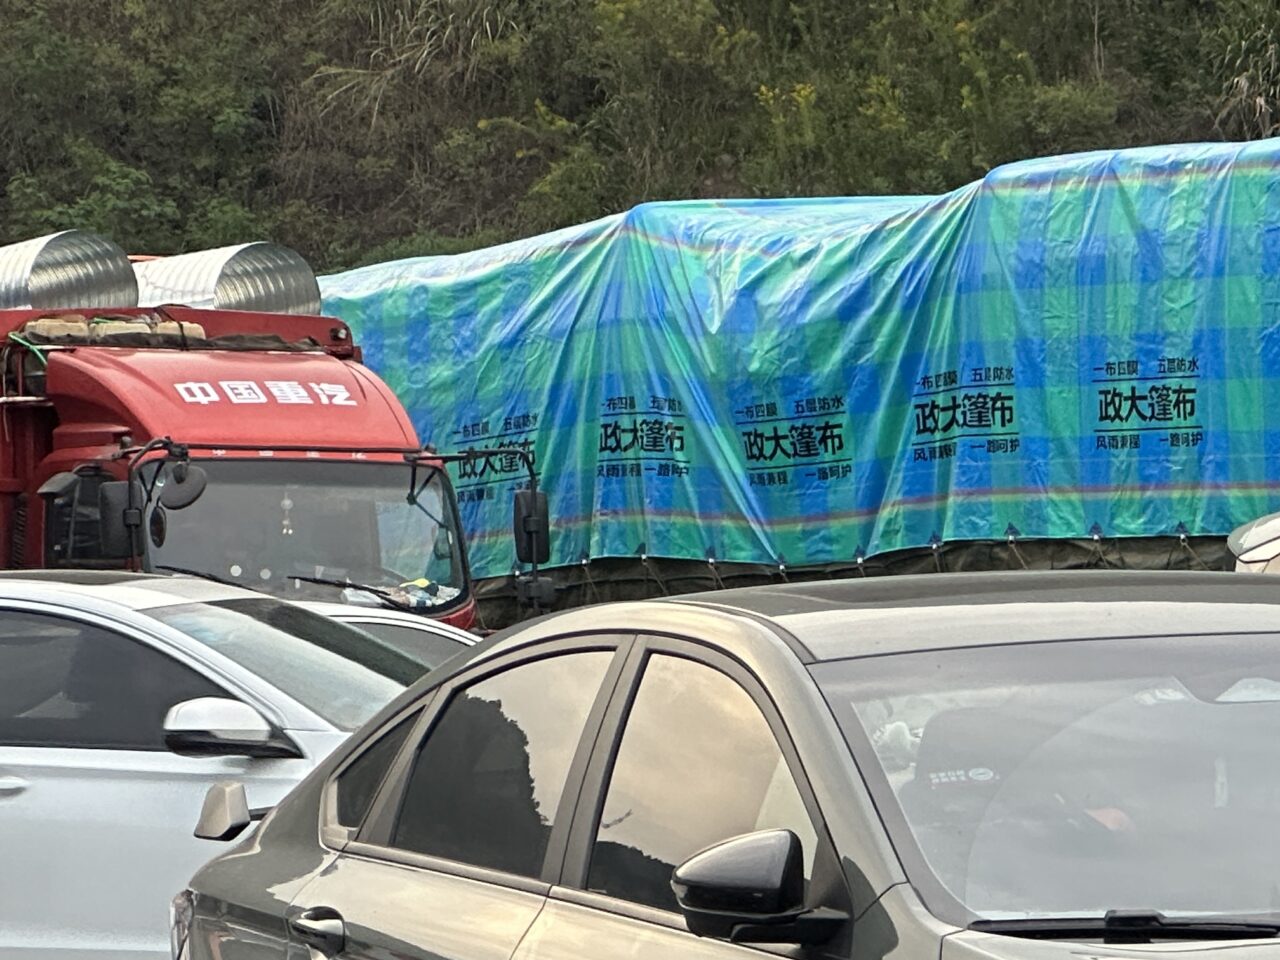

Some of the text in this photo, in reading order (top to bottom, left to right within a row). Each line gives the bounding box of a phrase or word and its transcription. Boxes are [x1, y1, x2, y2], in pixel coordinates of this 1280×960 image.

[174, 381, 357, 406] 中国重汽
[1098, 384, 1197, 423] 政大篷布
[914, 392, 1014, 435] 政大篷布
[599, 418, 684, 454] 政大篷布
[742, 421, 844, 462] 政大篷布
